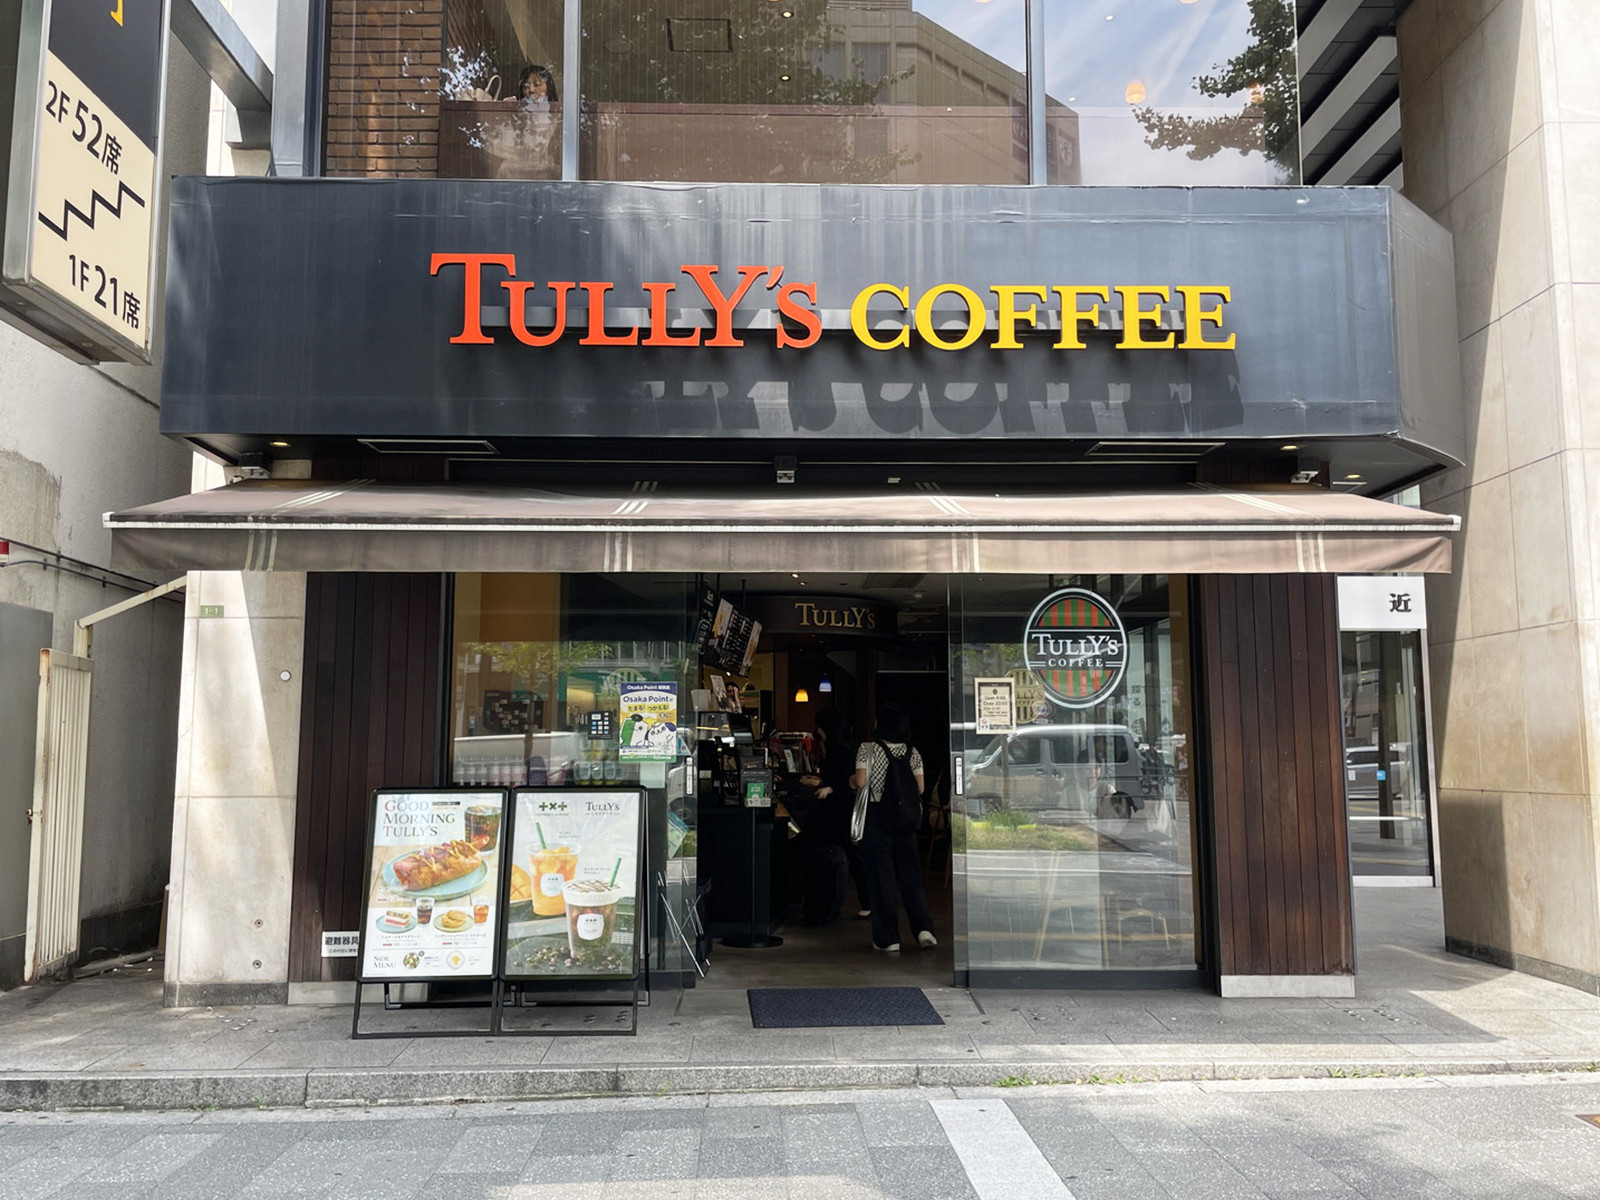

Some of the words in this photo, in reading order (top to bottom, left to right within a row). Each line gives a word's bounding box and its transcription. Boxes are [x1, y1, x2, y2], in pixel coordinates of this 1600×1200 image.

[45, 80, 71, 124] 2F
[71, 99, 123, 176] 52席
[69, 253, 90, 292] 1F
[93, 264, 141, 330] 21席
[429, 252, 824, 350] TULLY'S
[849, 282, 1237, 351] COFFEE
[1389, 593, 1412, 613] 近
[794, 602, 876, 630] TULLY'S
[1031, 633, 1119, 656] TULLY'S
[1048, 658, 1103, 668] COFFEE
[622, 695, 648, 703] Osaka
[384, 800, 430, 812] GOOD
[382, 813, 456, 825] MORNING
[382, 825, 439, 838] TULLY'S
